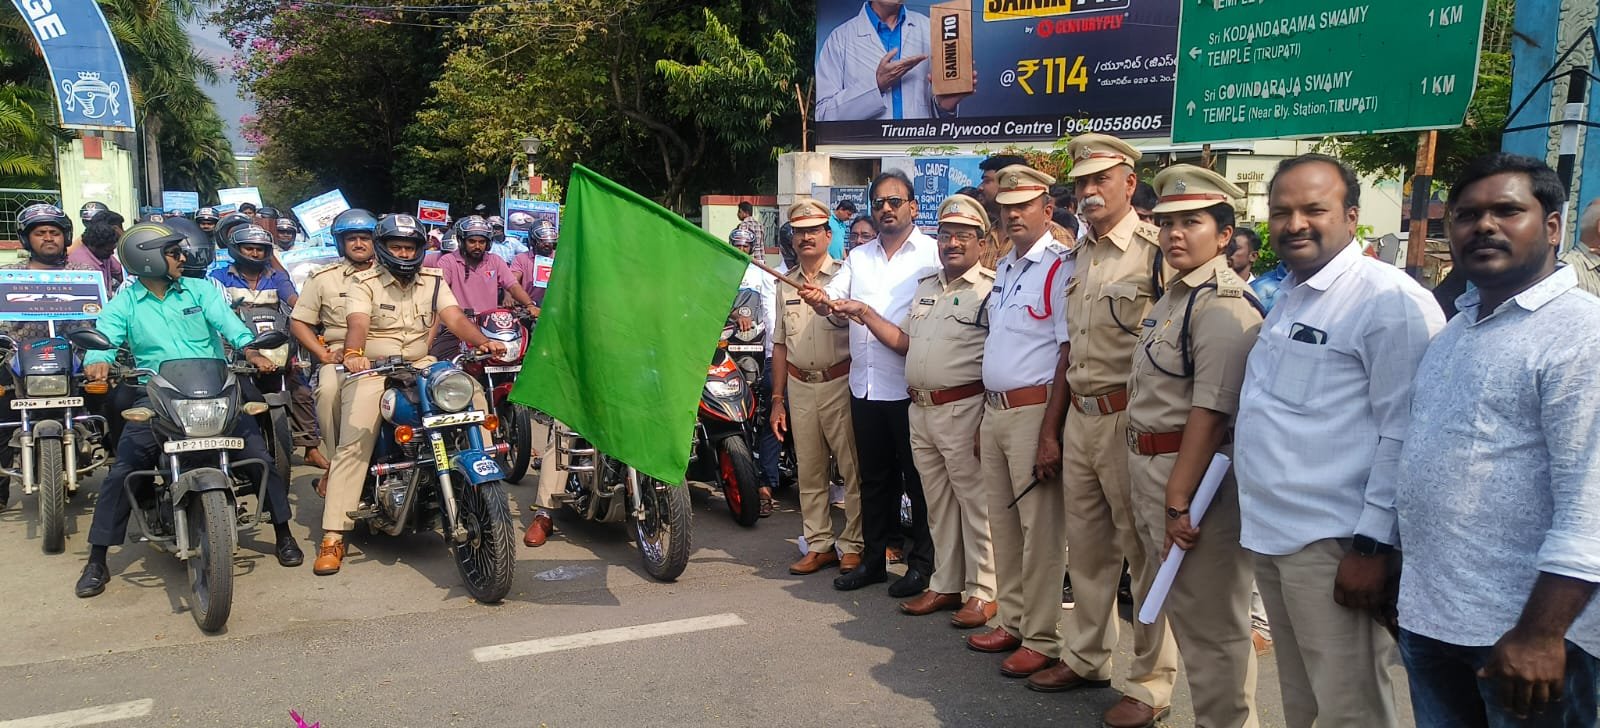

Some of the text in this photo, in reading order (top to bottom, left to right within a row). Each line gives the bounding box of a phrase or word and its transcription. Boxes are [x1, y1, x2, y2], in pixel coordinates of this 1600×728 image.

[1208, 5, 1369, 45] Sri KODANDARAMA SWAMY
[1428, 5, 1463, 28] 1 KM
[944, 16, 957, 78] SAINIK 710
[1207, 43, 1301, 67] TEMPLE (TIRUPATI)
[1204, 71, 1353, 102] Sri GOVINDARAJA SWAMY
[1421, 74, 1456, 96] 1 KM
[881, 123, 936, 138] Tirumala
[940, 121, 1000, 139] Plywood
[1004, 120, 1053, 135] Centre
[1066, 114, 1162, 134] 9640558605
[1203, 105, 1246, 124] TEMPLE
[1248, 106, 1272, 121] (Near
[1274, 106, 1290, 120] Rly.
[925, 163, 949, 177] CADET
